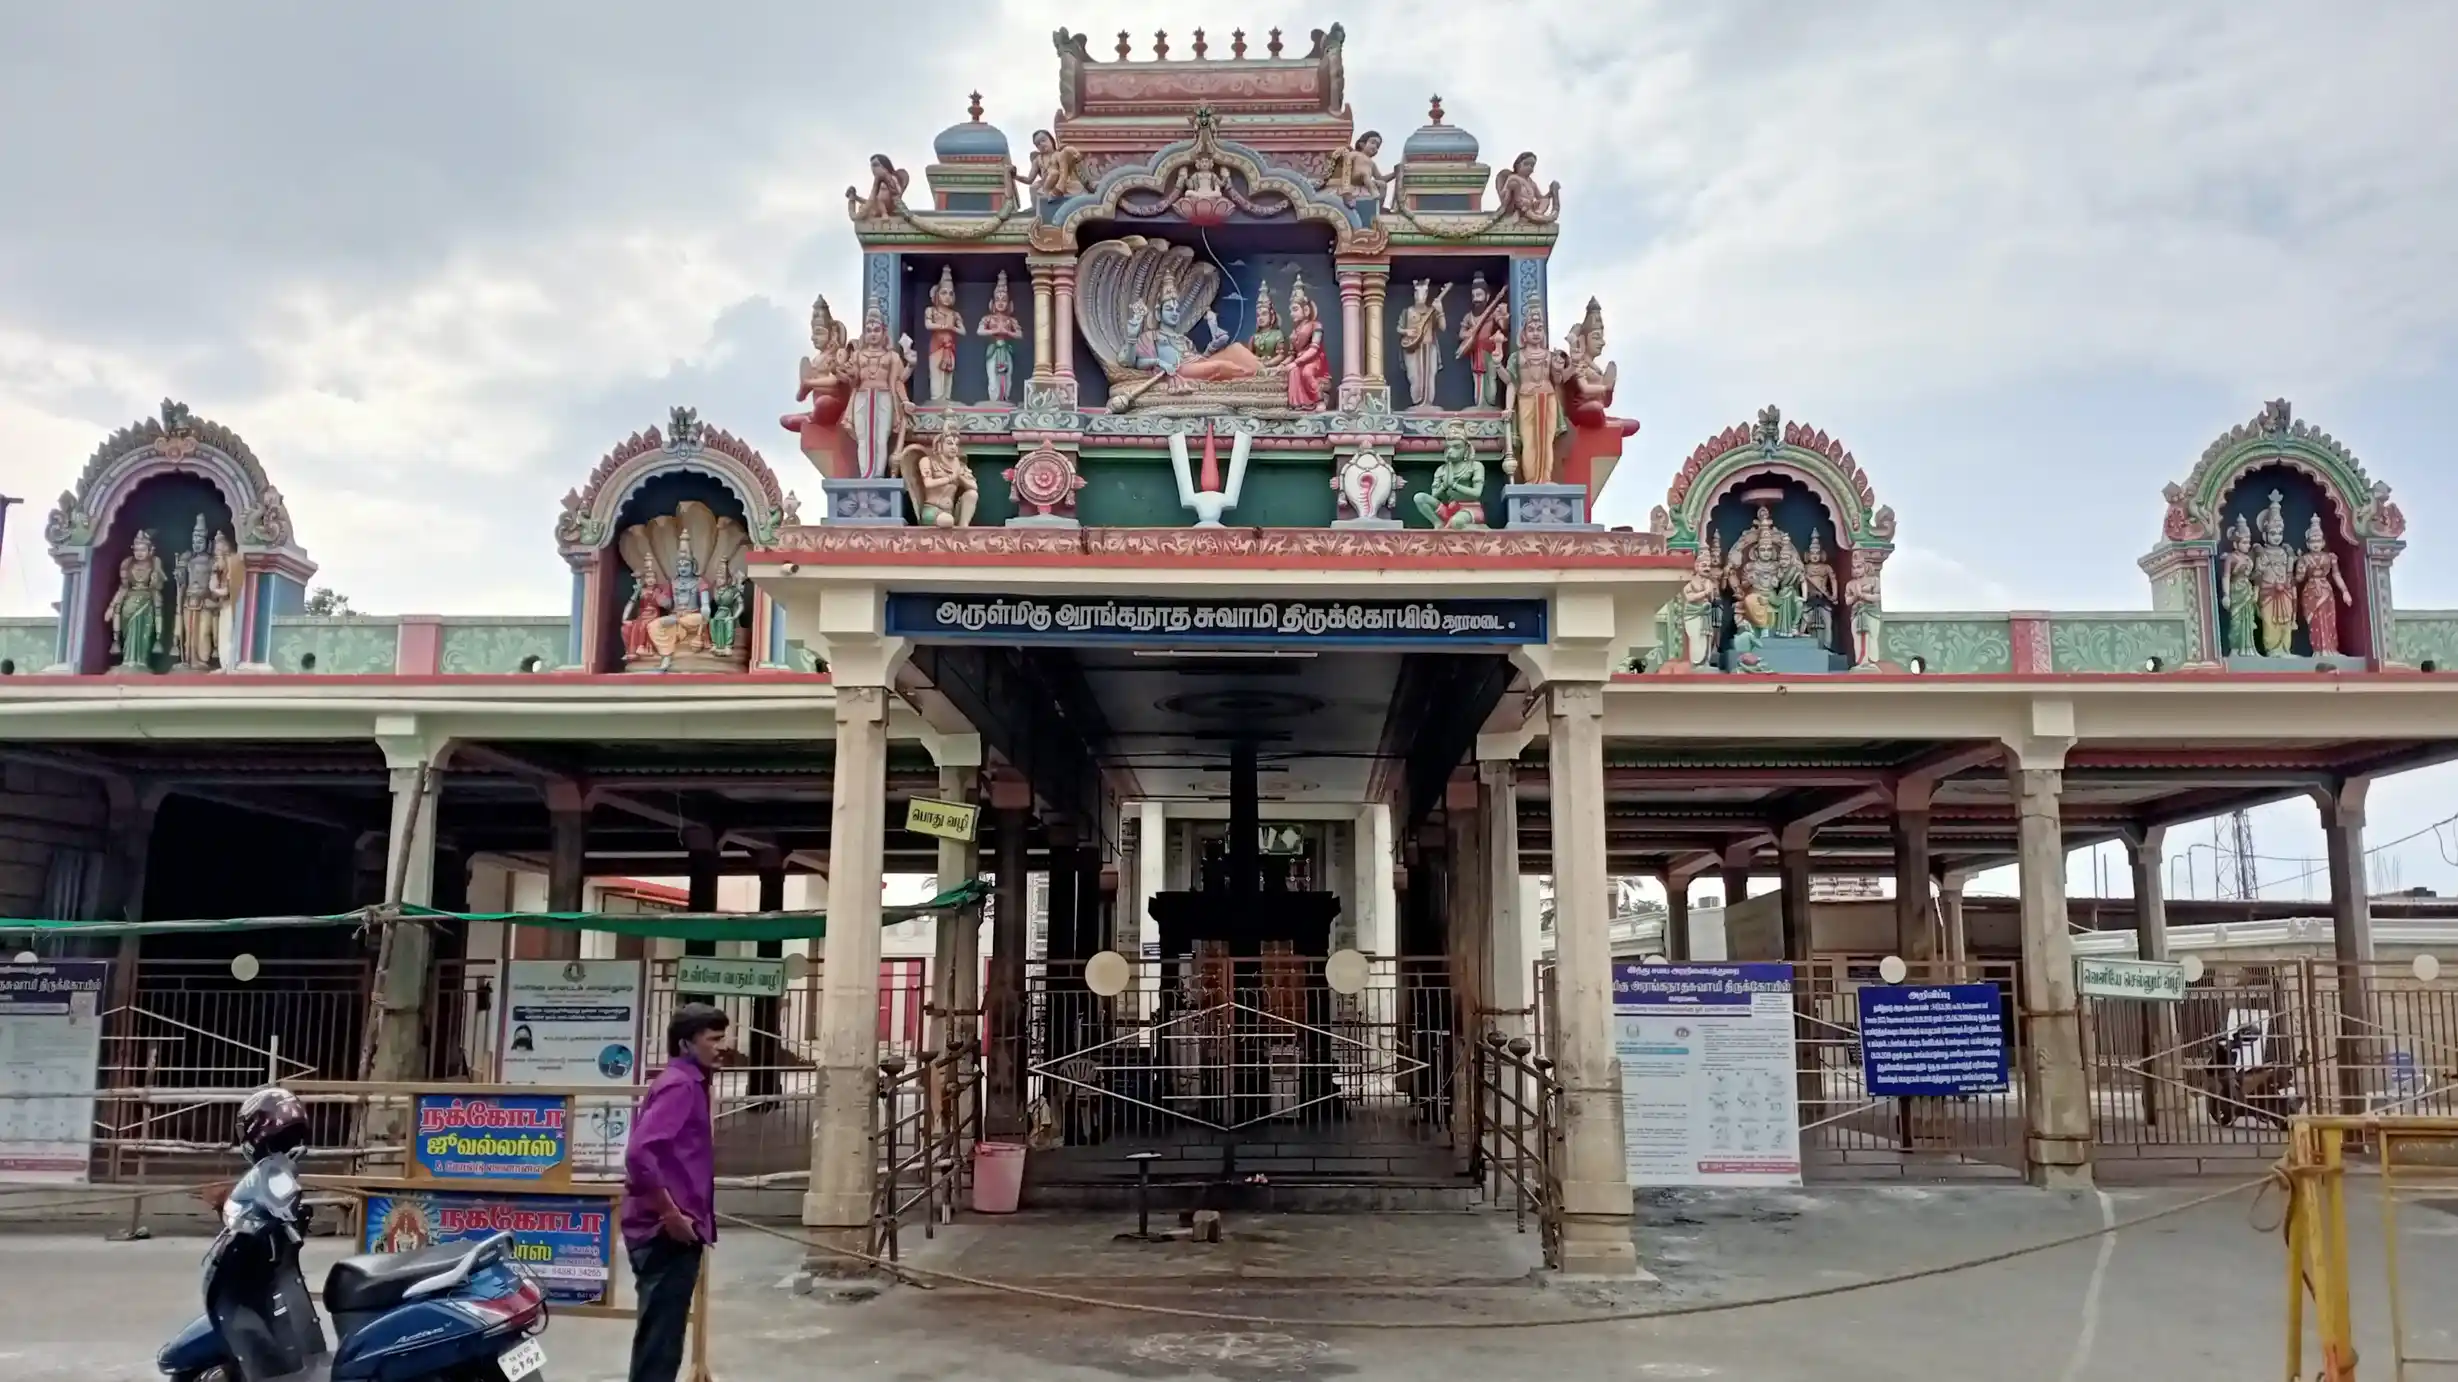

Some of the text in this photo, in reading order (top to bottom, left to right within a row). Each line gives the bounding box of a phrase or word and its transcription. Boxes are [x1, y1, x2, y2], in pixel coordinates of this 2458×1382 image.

[935, 599, 1052, 631] அருள்மிகு
[1278, 602, 1441, 635] திருக்கோயில்
[912, 808, 969, 833] பொது வழி
[723, 967, 756, 989] வரும்
[757, 969, 780, 991] வழி
[1724, 978, 1791, 994] திருக்கோயில்
[2084, 967, 2181, 995] வெளியே செல்லும் வழி
[1908, 988, 1951, 1000] அறிவிப்பு
[420, 1098, 566, 1133] நக்கோடா
[426, 1132, 557, 1158] ஜூவல்லர்ஸ்
